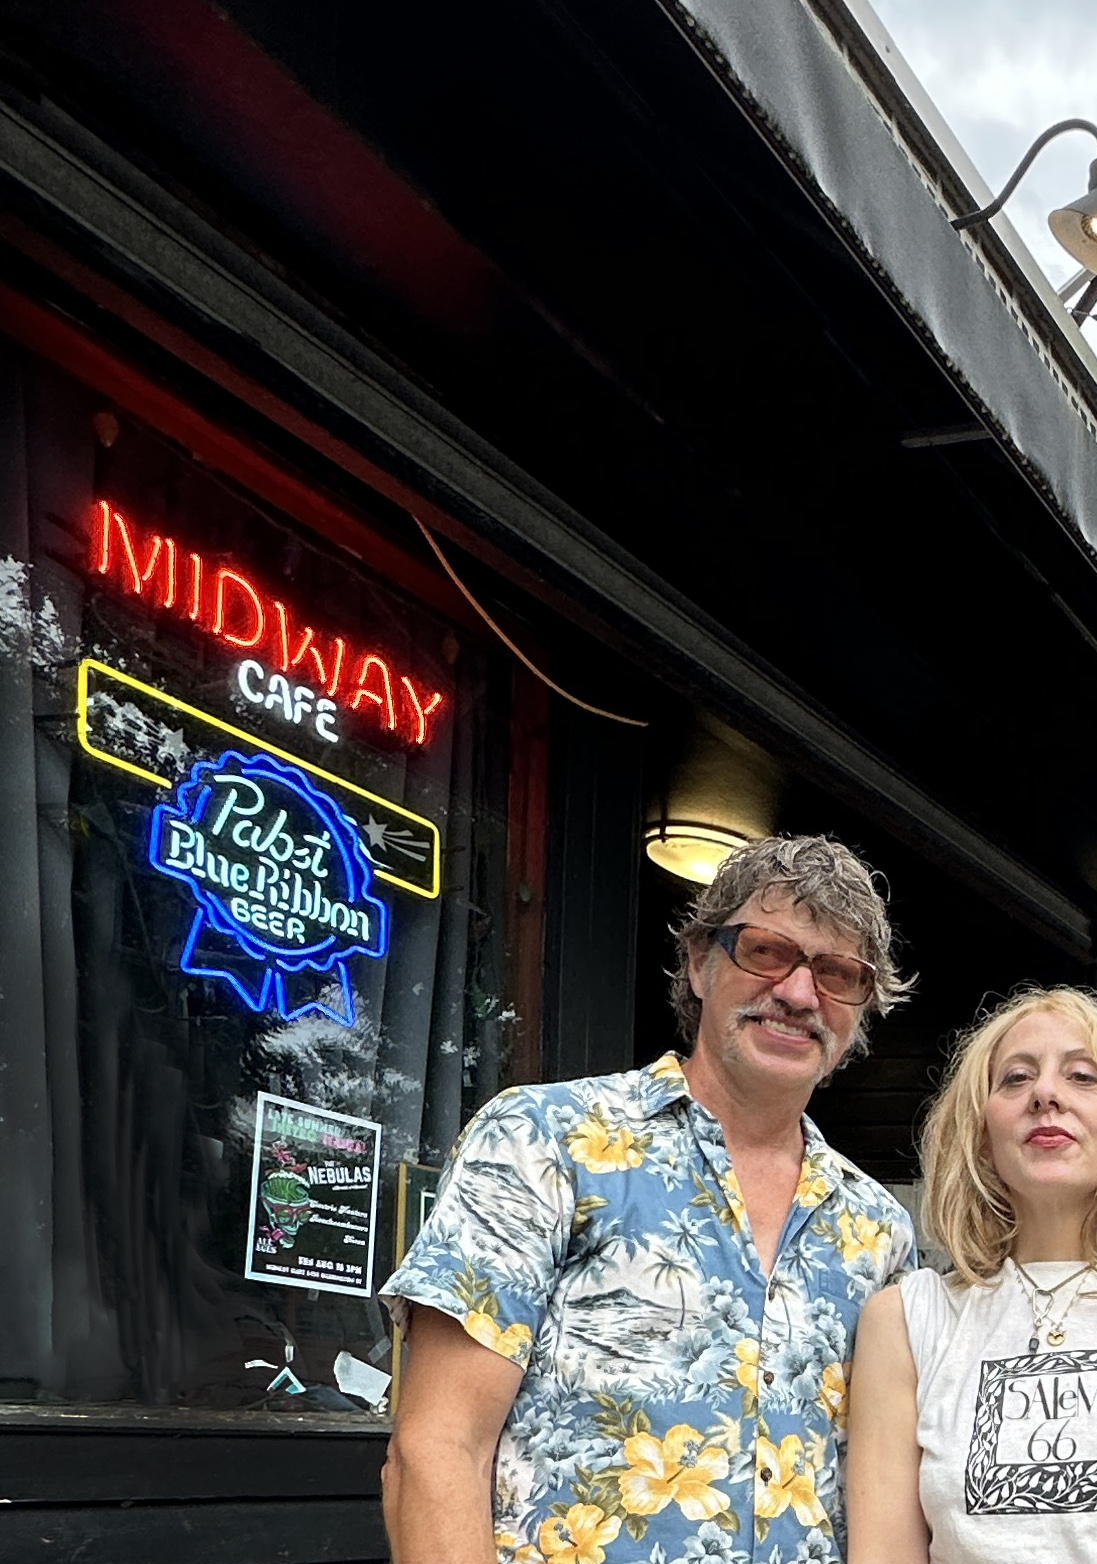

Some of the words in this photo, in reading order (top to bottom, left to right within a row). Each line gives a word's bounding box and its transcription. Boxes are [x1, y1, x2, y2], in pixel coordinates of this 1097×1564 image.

[98, 499, 443, 745] MIDWAY
[238, 659, 340, 744] CAFE
[213, 774, 332, 878] Pabst
[165, 819, 250, 893] Blue
[248, 856, 370, 942] Ribbon
[230, 897, 306, 944] BEER
[307, 1166, 372, 1185] NEBULAS
[1027, 1419, 1077, 1463] 66
